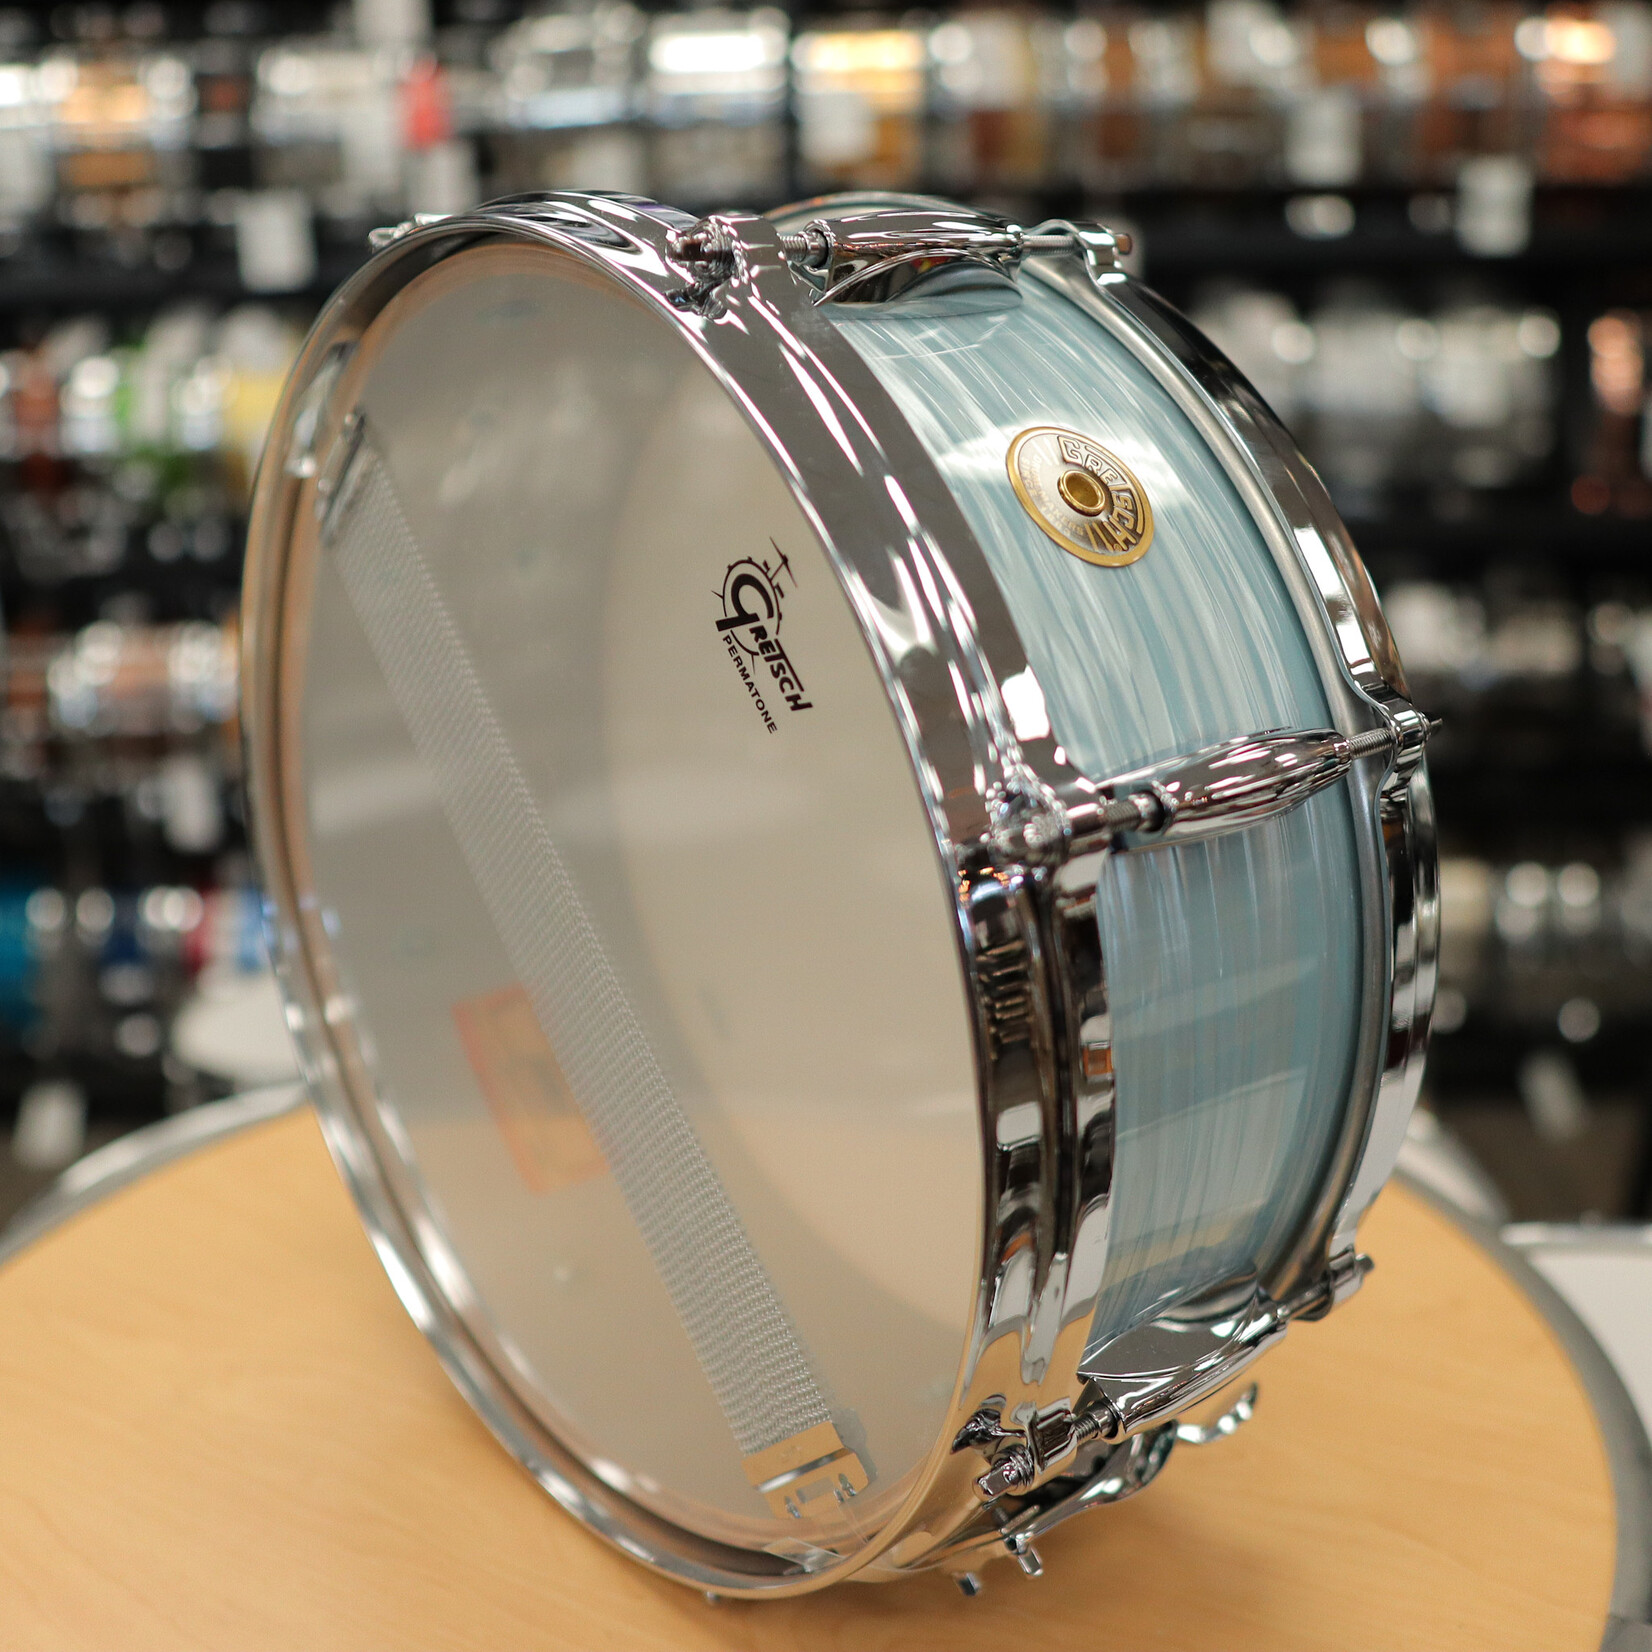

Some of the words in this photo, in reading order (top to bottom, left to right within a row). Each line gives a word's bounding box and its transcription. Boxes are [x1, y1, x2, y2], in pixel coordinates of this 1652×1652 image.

[1057, 435, 1147, 551] GRETSCH
[715, 573, 813, 711] GRETSCH
[722, 634, 778, 734] PERMATONE
